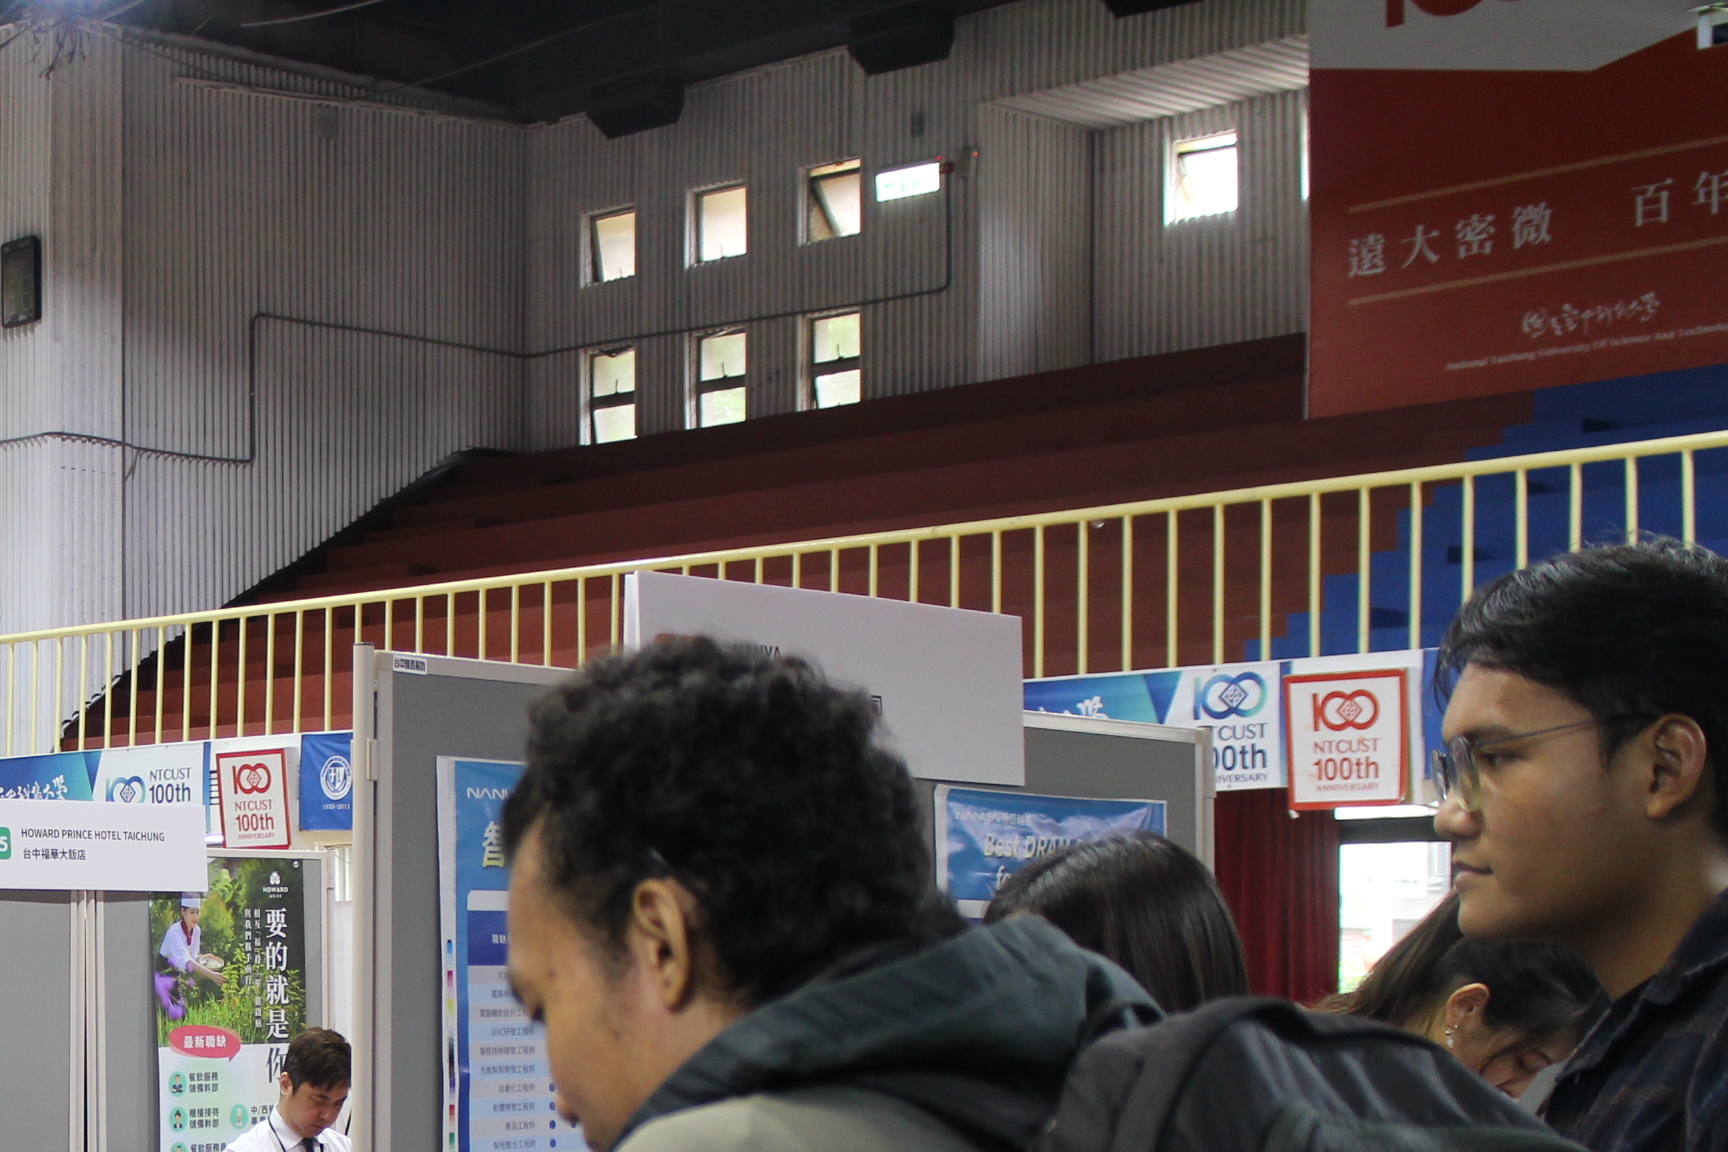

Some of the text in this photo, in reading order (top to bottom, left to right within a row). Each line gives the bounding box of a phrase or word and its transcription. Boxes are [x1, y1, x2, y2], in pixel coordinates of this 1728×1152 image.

[1314, 738, 1381, 755] NTCUST
[149, 767, 192, 781] NTCUST
[1313, 755, 1380, 781] 100th
[149, 782, 192, 804] 100th
[1316, 782, 1381, 792] ANNIVERSARY
[234, 799, 274, 812] NTCUST
[235, 812, 275, 832] 100th
[21, 827, 165, 842] HOWARD PRINCE HOTEL TAICHUNG
[238, 832, 276, 841] ANNIVERSARY
[983, 833, 1021, 858] Best
[23, 848, 86, 861] 台中福華大飯店
[183, 1034, 227, 1049] 最新職缺
[188, 1072, 219, 1082] 餐飲服務
